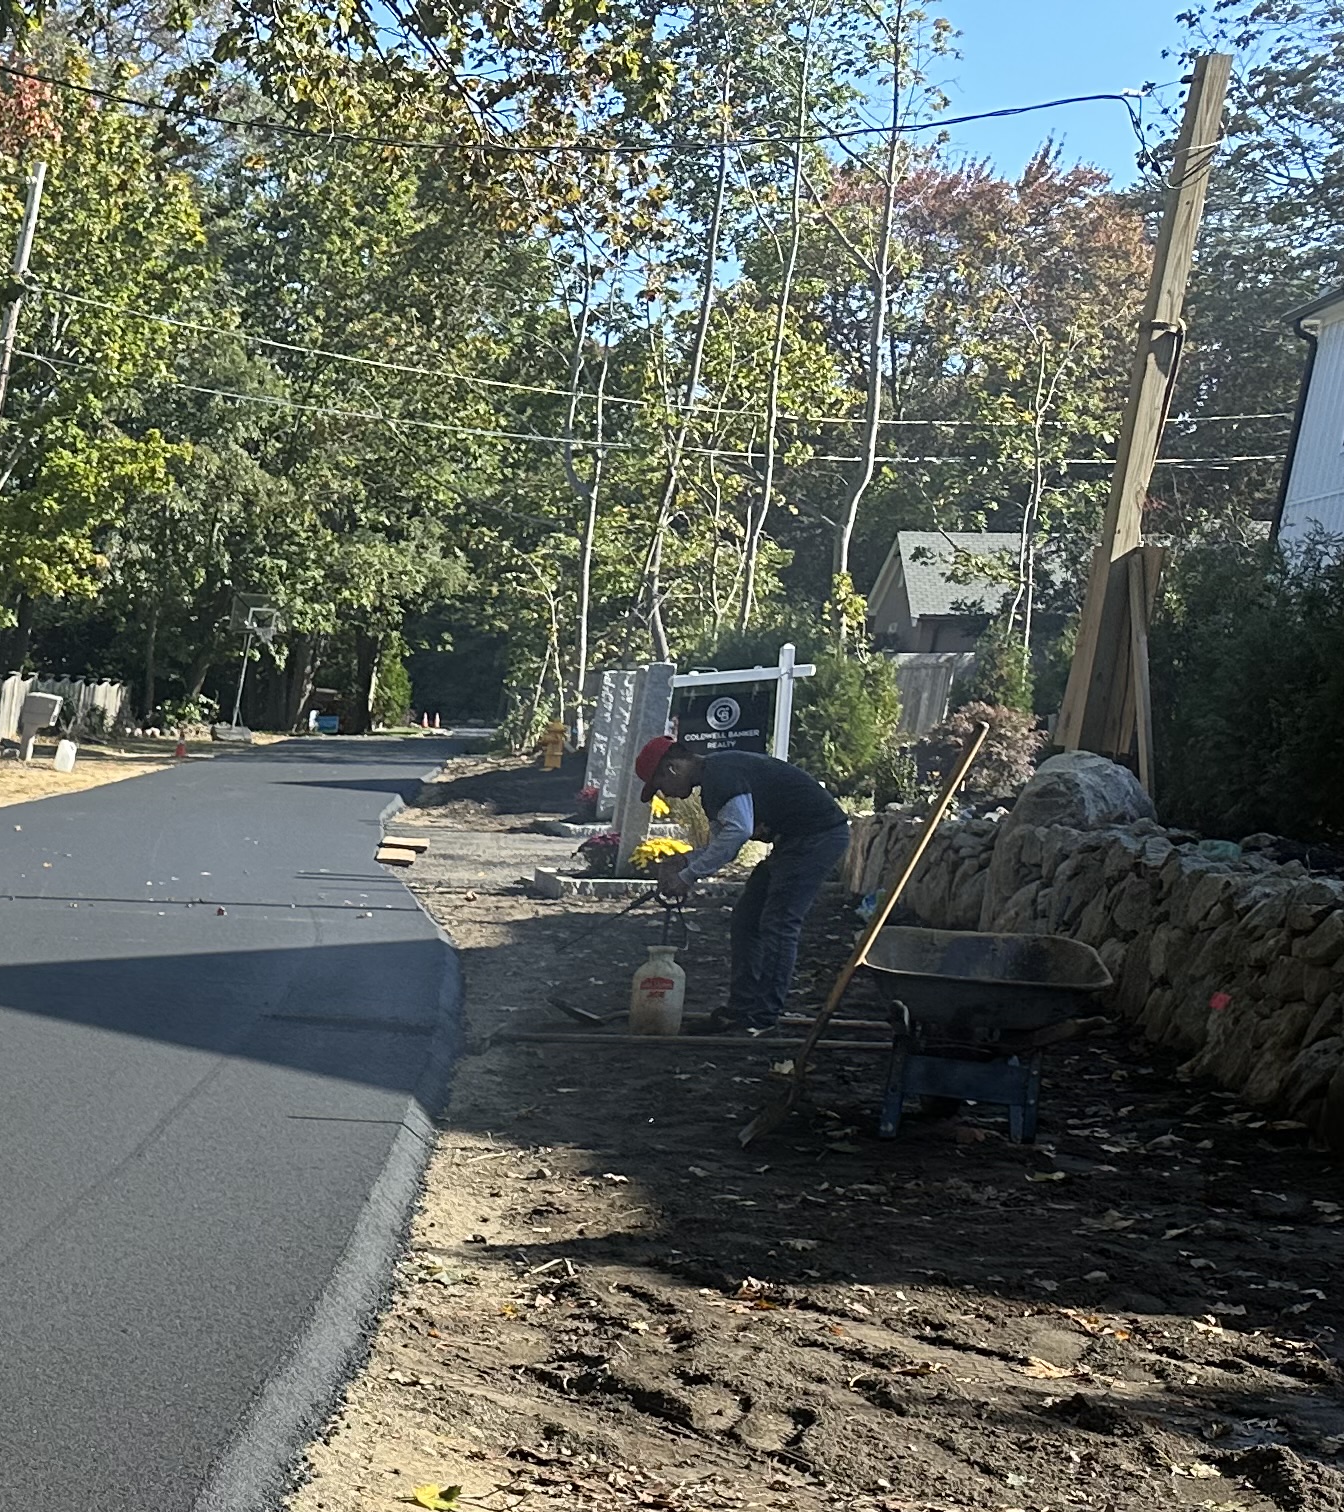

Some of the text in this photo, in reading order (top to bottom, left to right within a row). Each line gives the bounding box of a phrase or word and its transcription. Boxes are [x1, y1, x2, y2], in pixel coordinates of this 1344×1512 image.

[684, 729, 760, 742] COLDWELL BANKER
[706, 741, 737, 749] REALTY
